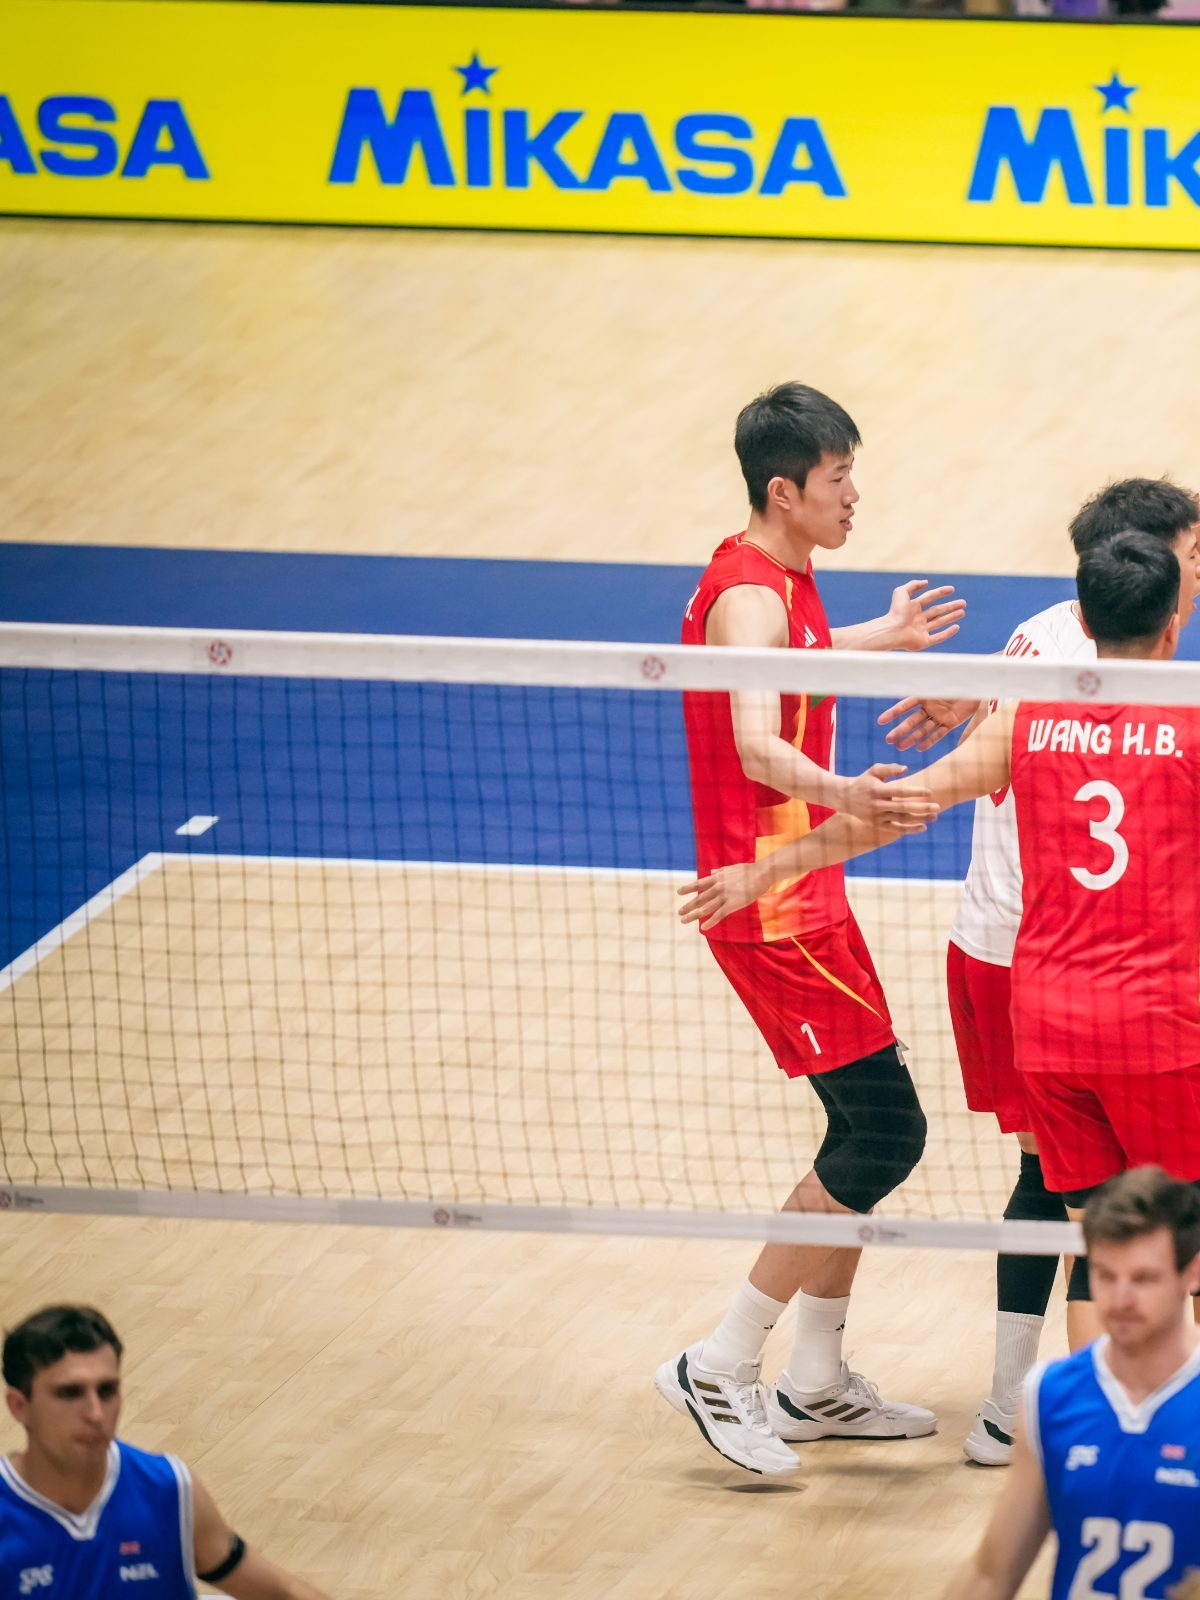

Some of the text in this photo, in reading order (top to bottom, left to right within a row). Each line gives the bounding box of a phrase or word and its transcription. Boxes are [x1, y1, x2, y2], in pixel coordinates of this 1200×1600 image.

[1028, 719, 1184, 758] WANG H.B.
[1070, 780, 1130, 891] 3
[800, 1022, 822, 1055] 1
[1068, 1516, 1175, 1600] 22
